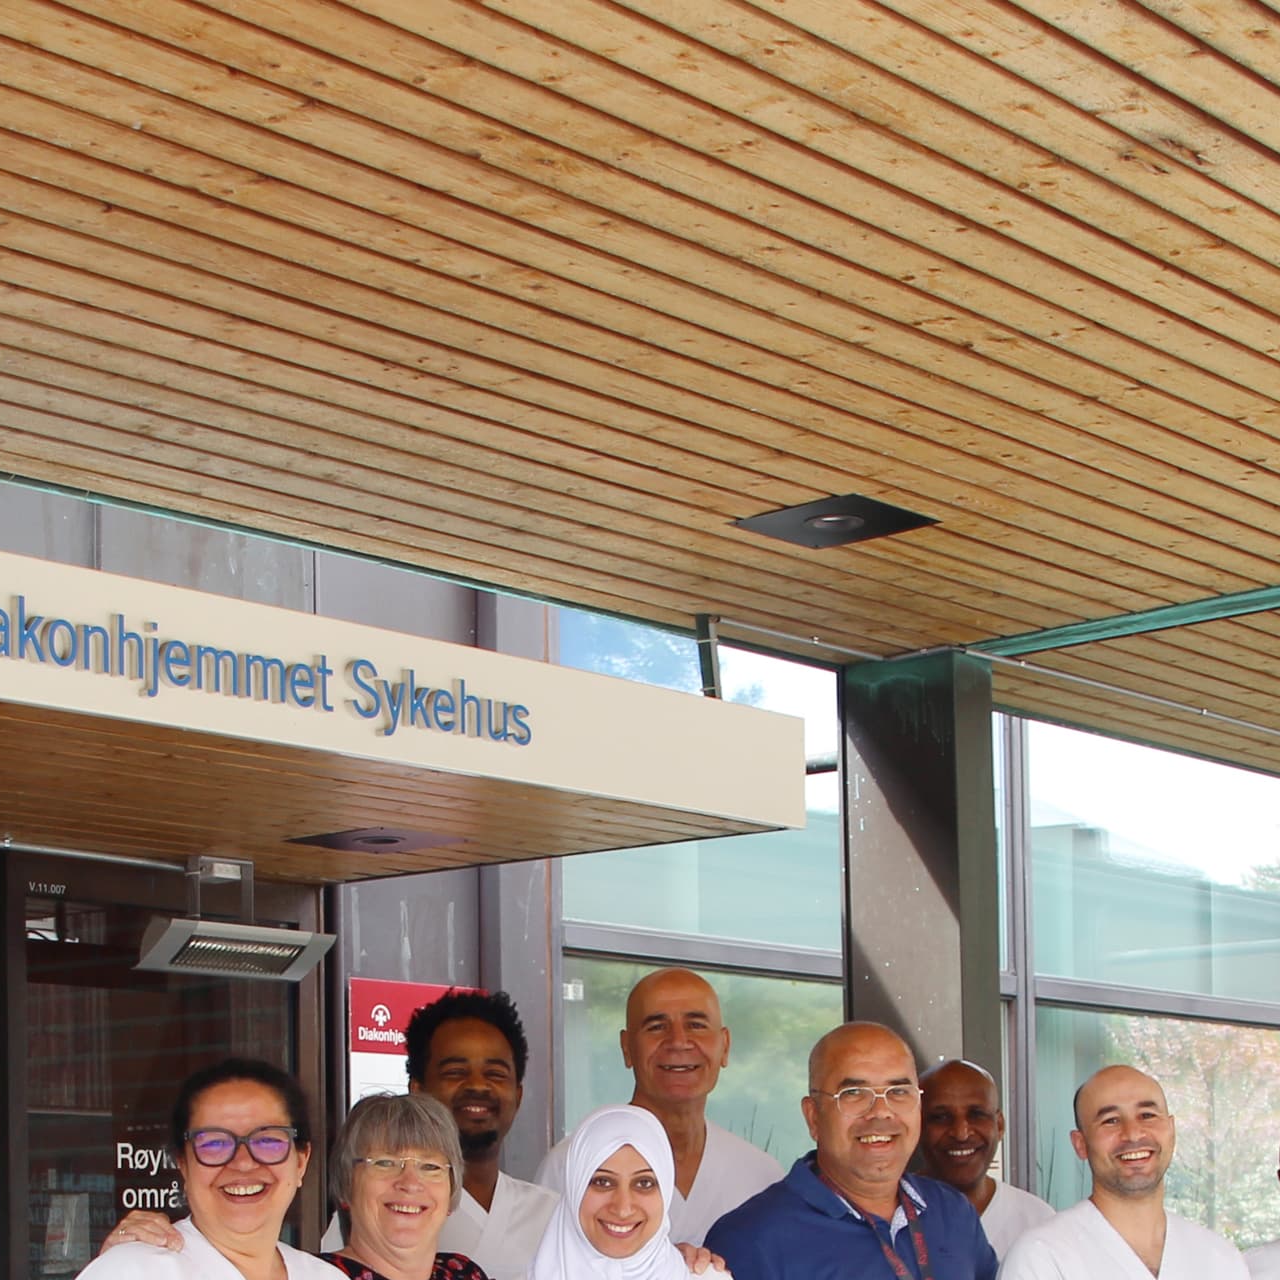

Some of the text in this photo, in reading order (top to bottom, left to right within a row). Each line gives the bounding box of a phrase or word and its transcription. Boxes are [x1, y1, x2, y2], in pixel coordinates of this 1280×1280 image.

[344, 658, 533, 747] Sykehus
[28, 881, 66, 895] V.11.007
[358, 1026, 407, 1046] Diakonhje
[116, 1142, 179, 1176] Røyk
[122, 1180, 183, 1208] områ
